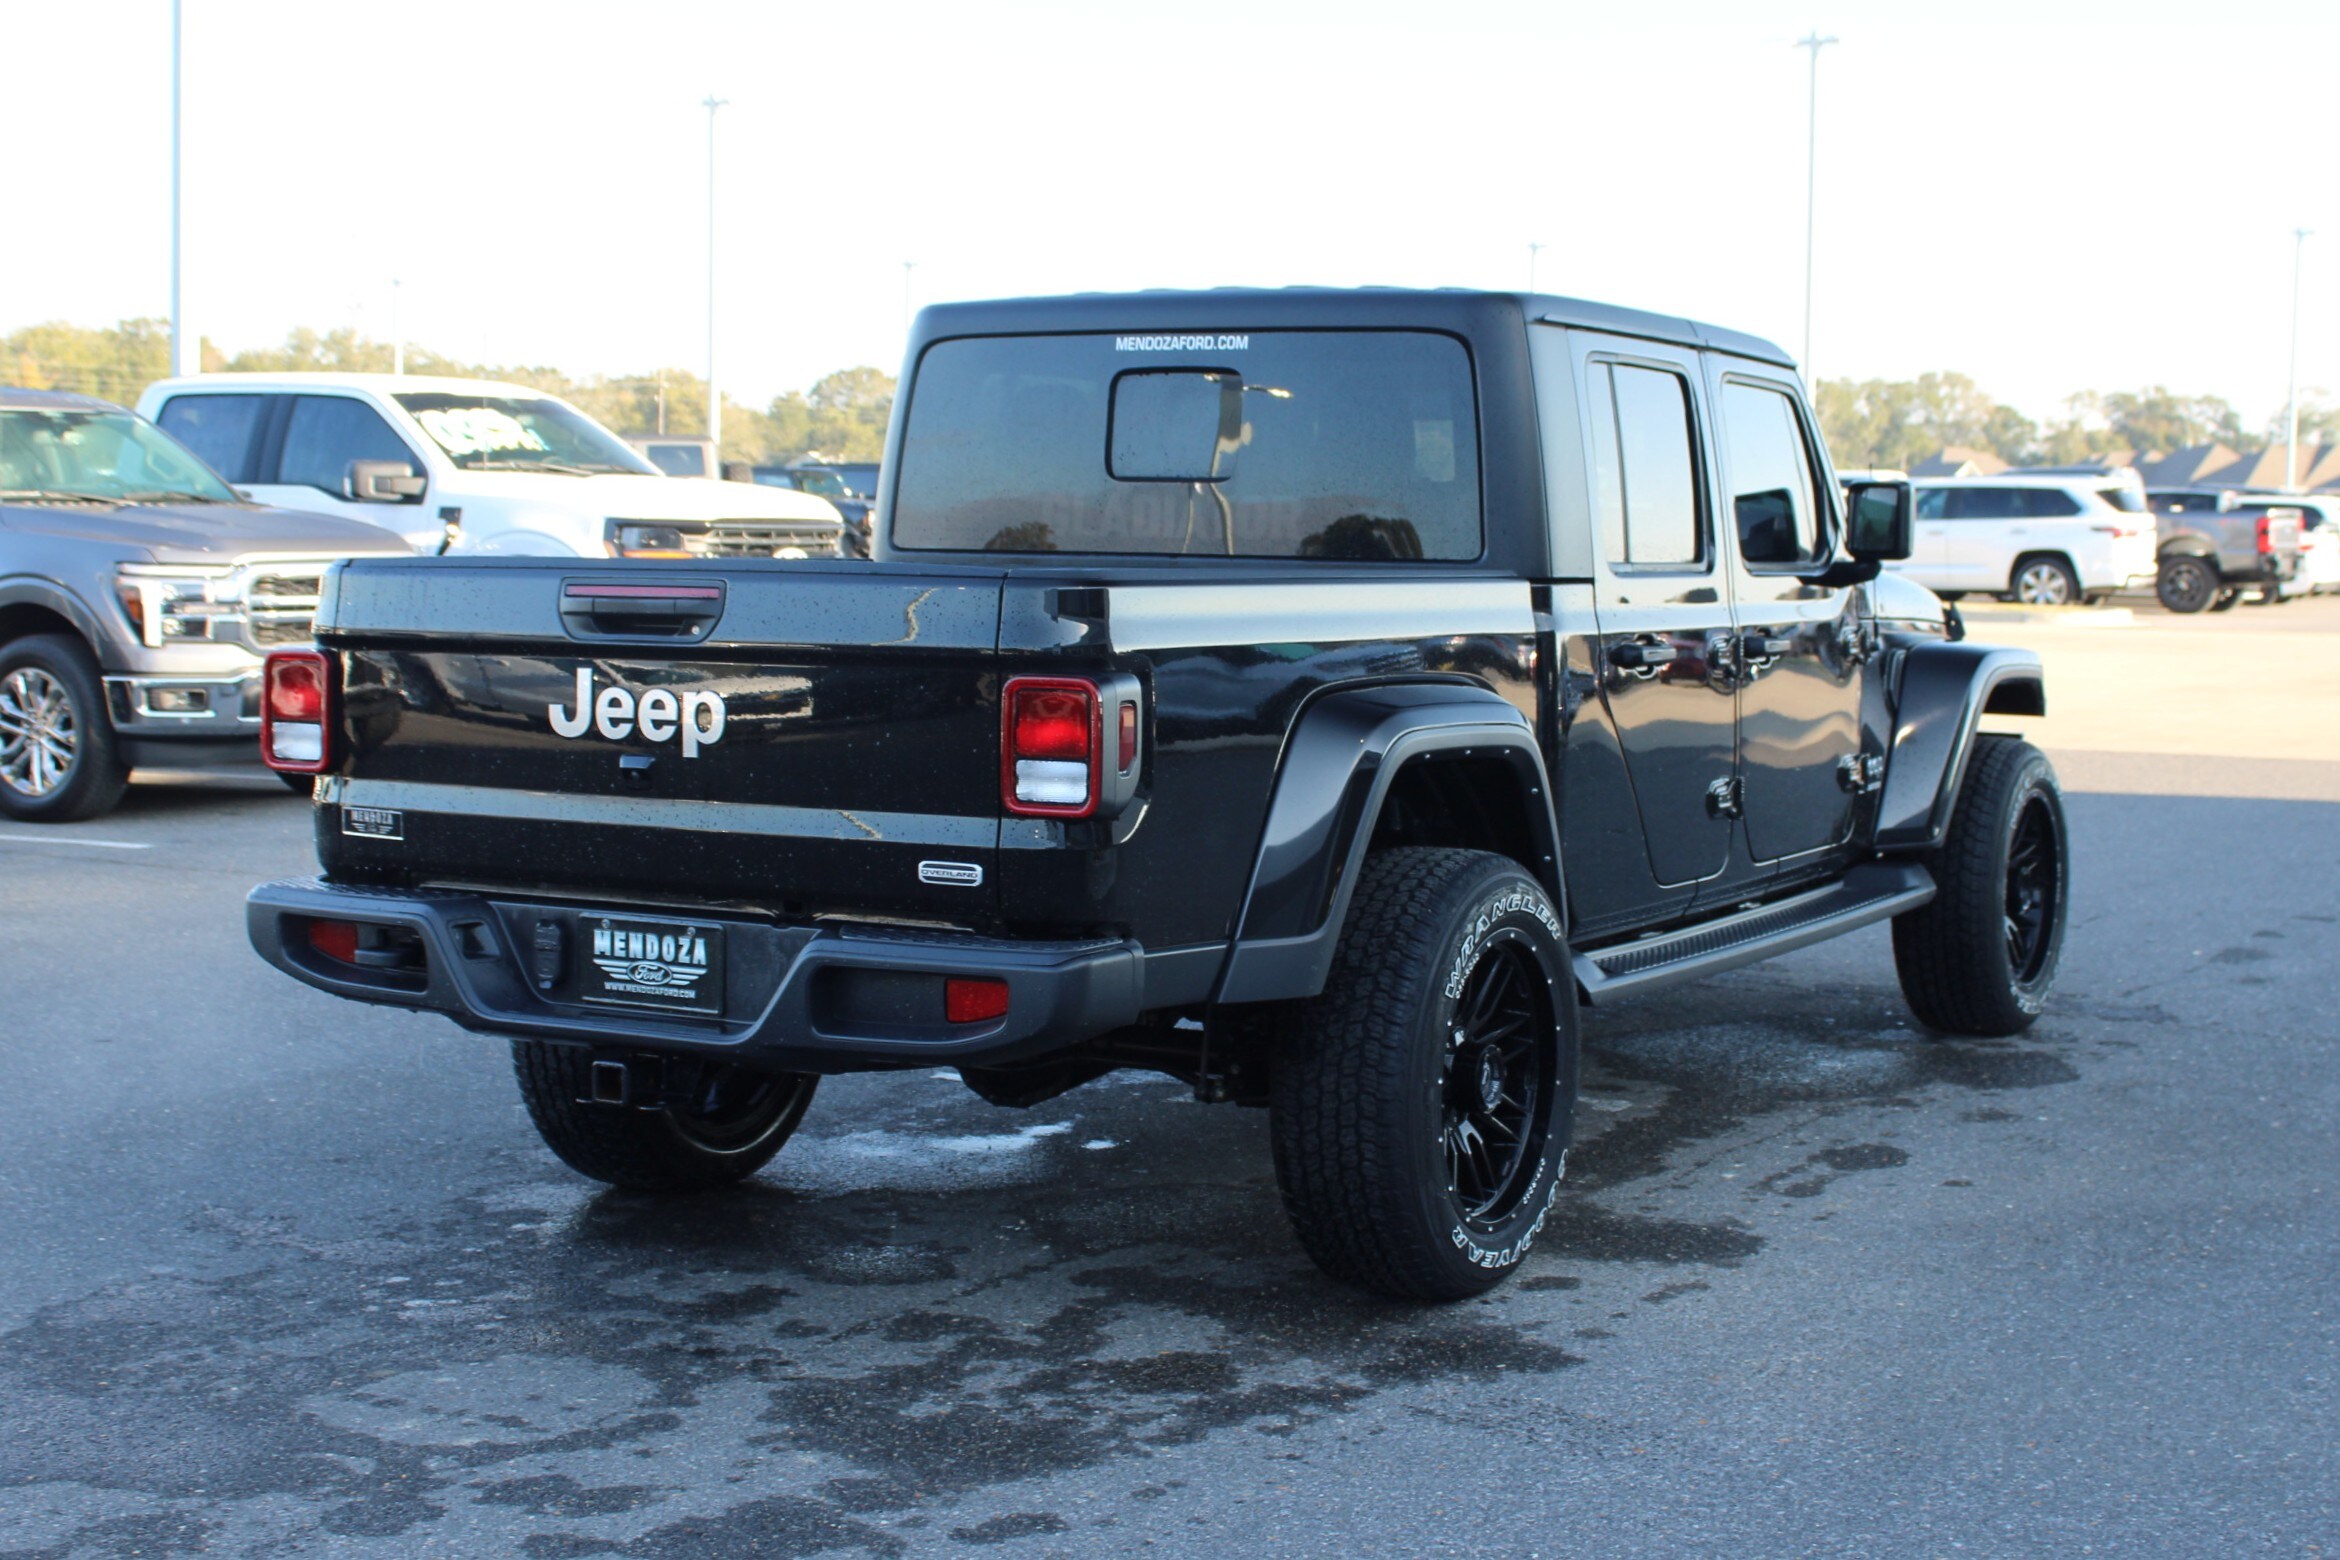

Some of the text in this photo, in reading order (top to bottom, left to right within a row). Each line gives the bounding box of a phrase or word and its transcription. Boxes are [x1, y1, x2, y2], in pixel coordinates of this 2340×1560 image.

[1115, 335, 1249, 351] MENDOZAFORD.COM
[548, 667, 726, 758] Jeep
[920, 868, 979, 879] OVERLAND
[593, 928, 707, 966] MENDOZA
[1445, 893, 1561, 999] WRANGLER
[634, 963, 666, 982] Ford
